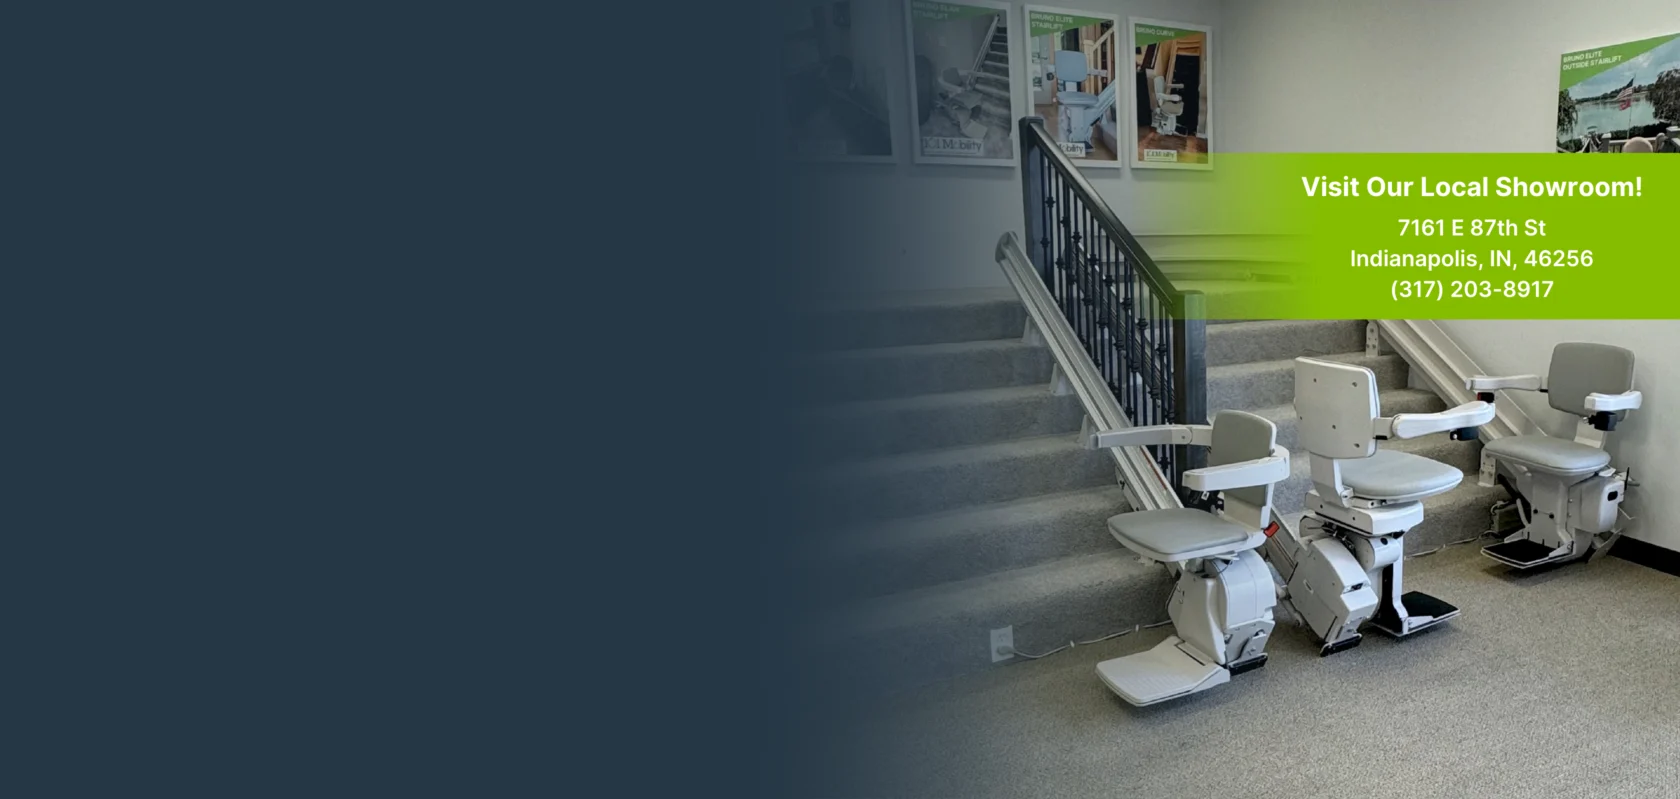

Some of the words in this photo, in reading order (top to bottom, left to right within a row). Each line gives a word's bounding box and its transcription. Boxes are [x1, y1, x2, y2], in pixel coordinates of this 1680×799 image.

[1031, 13, 1054, 22] BRUNO
[1055, 15, 1073, 23] ELITE
[1032, 21, 1064, 30] STAIRLIFT
[1563, 54, 1585, 63] BRUNO
[1585, 50, 1603, 59] ELITE
[1563, 61, 1589, 70] OUTSIDE
[1590, 55, 1622, 66] STAIRLIFT
